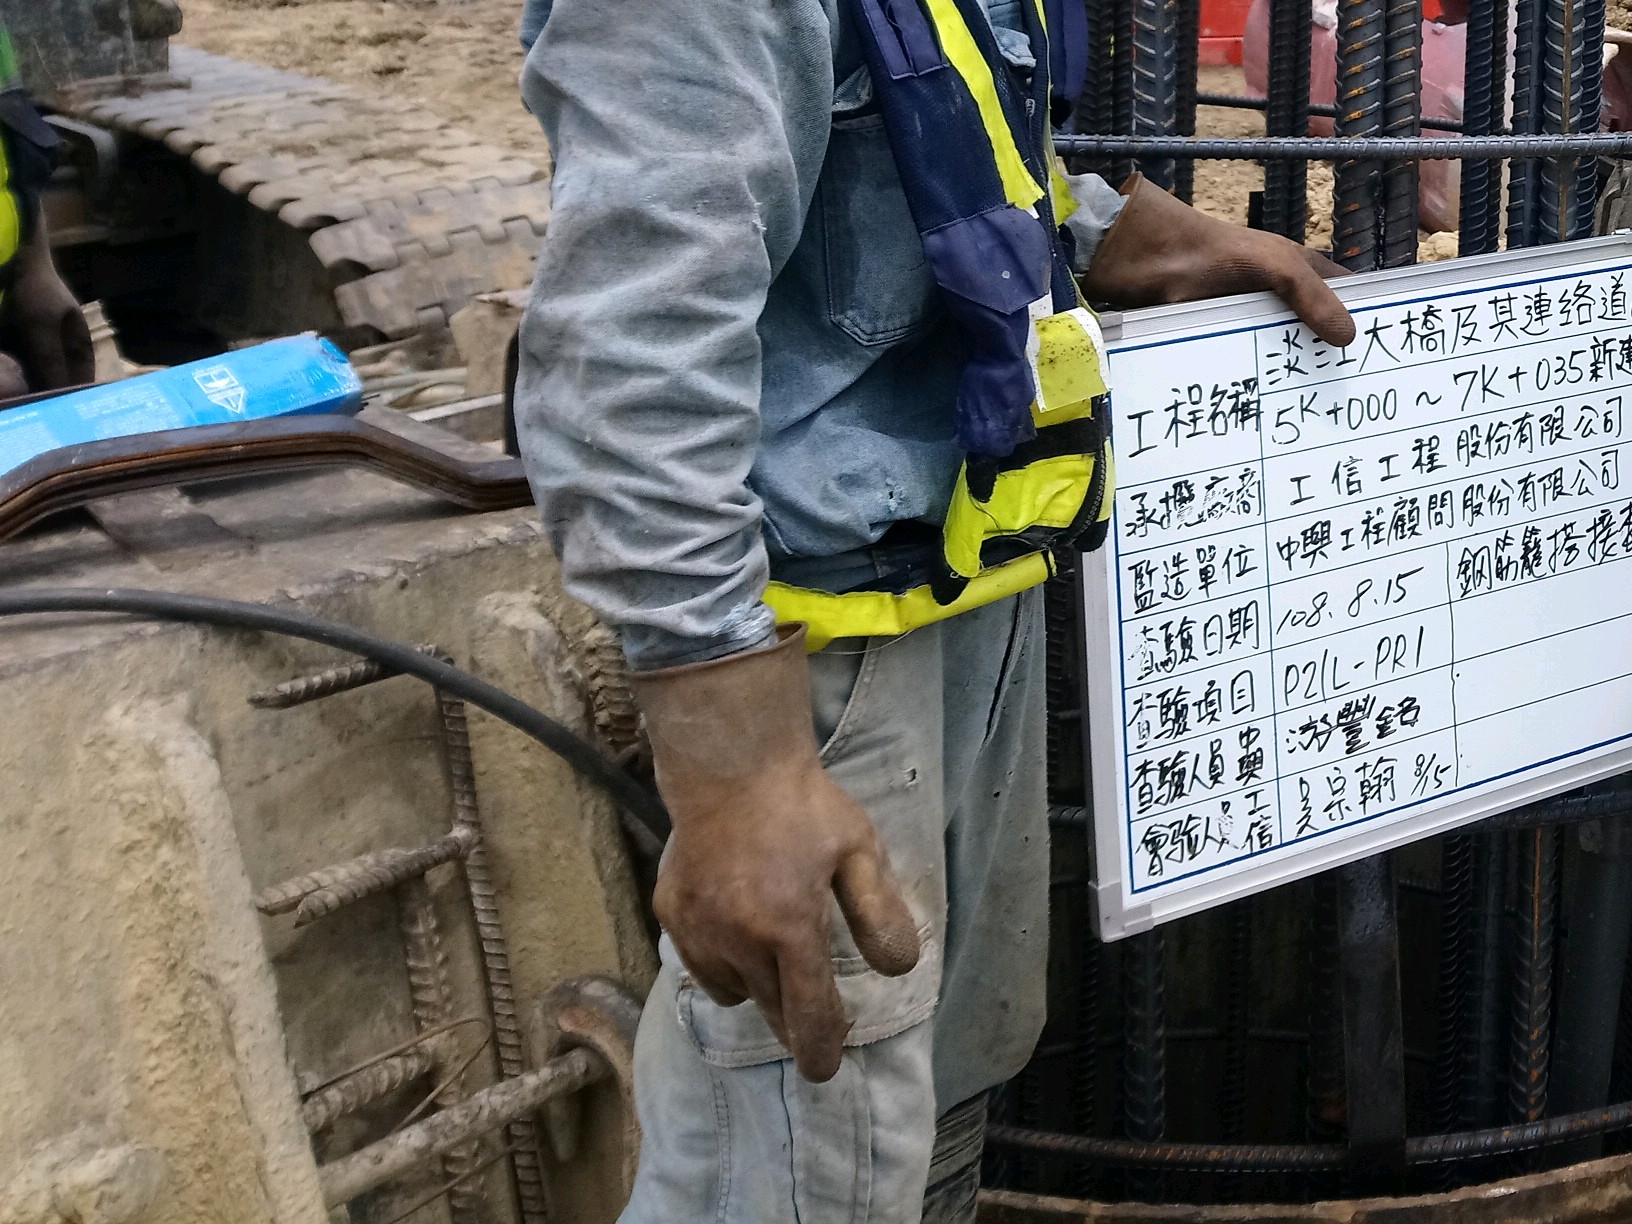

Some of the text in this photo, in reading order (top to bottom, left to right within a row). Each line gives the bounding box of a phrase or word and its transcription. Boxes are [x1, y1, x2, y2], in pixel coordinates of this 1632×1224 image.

[1127, 377, 1261, 458] 工程名稱
[1290, 396, 1622, 506] 工信工程股份有限公司
[1276, 449, 1618, 571] 中興工程顧問股份有限公司
[1128, 545, 1258, 614] 監造單位
